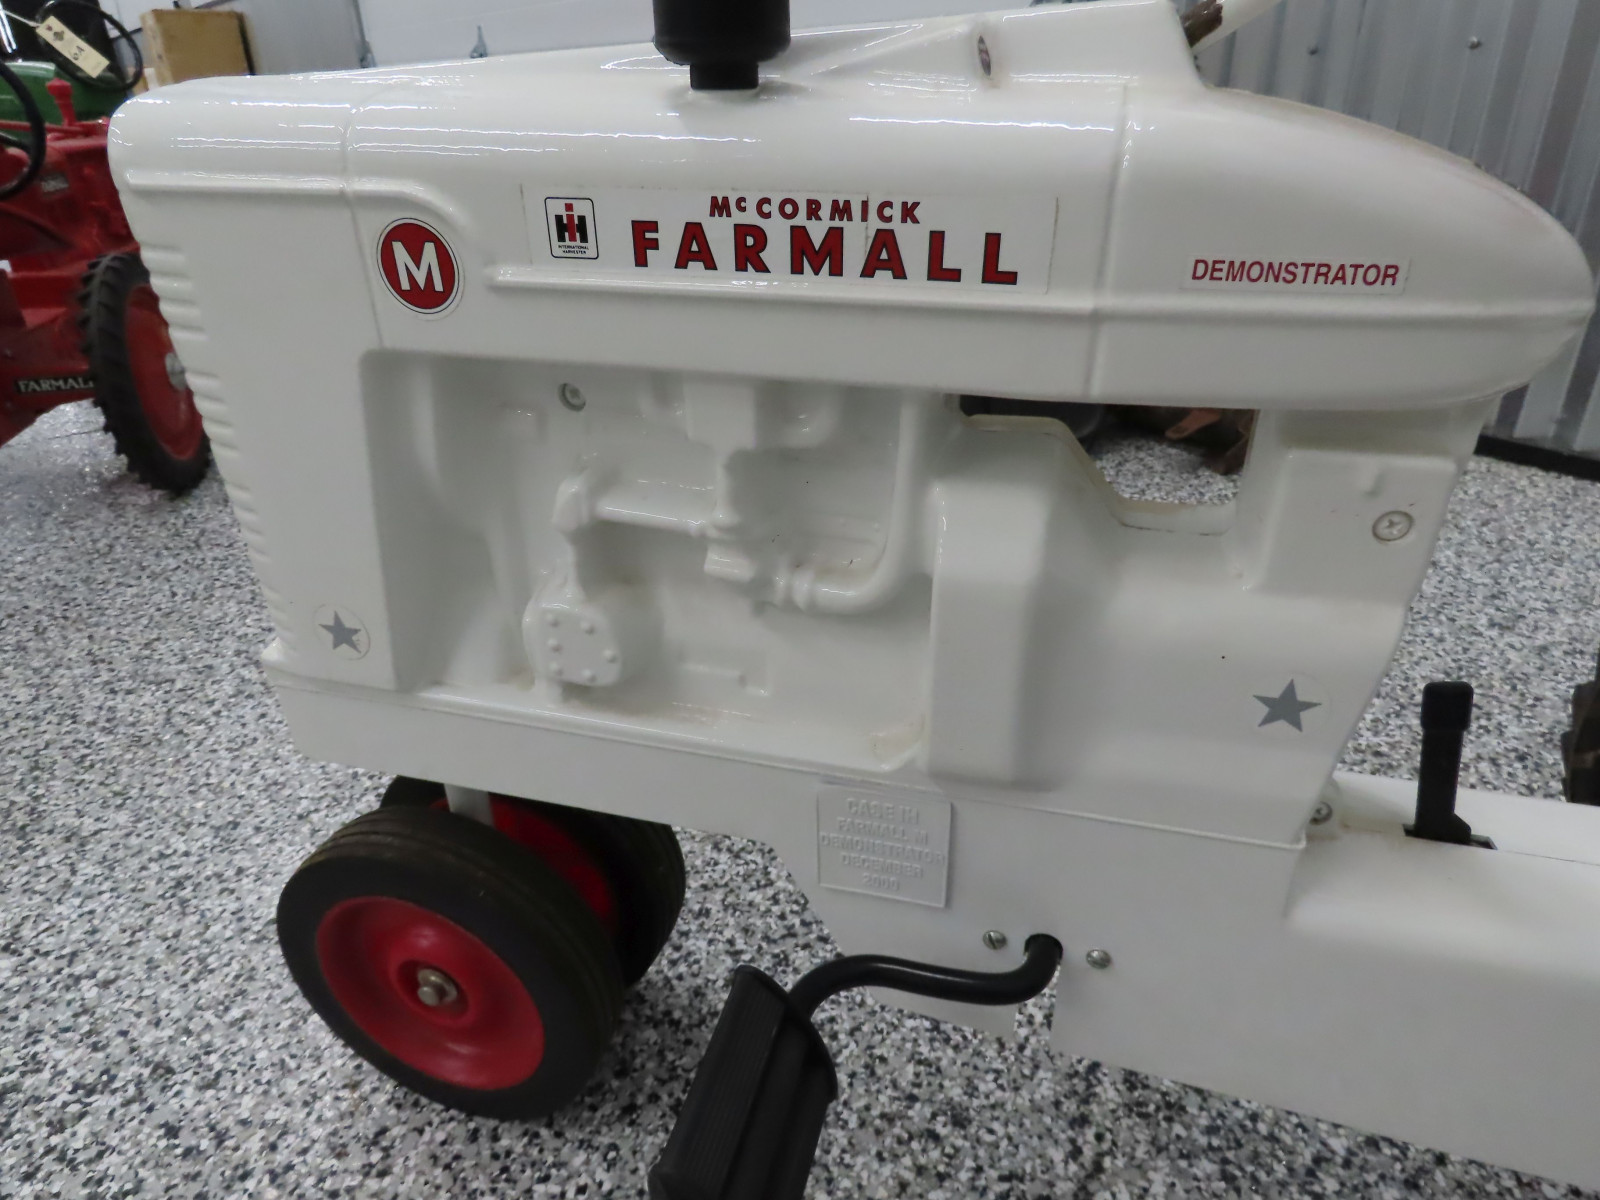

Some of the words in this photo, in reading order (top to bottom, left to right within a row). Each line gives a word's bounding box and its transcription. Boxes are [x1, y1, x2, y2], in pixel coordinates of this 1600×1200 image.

[391, 241, 444, 292] M
[631, 219, 1019, 285] FARMALL
[1191, 259, 1400, 286] DEMONSTRATOR
[846, 797, 894, 819] CASE
[836, 816, 908, 840] FARMALL
[820, 831, 946, 865] DEMONSTRATOR
[840, 851, 924, 880] DECEMBER
